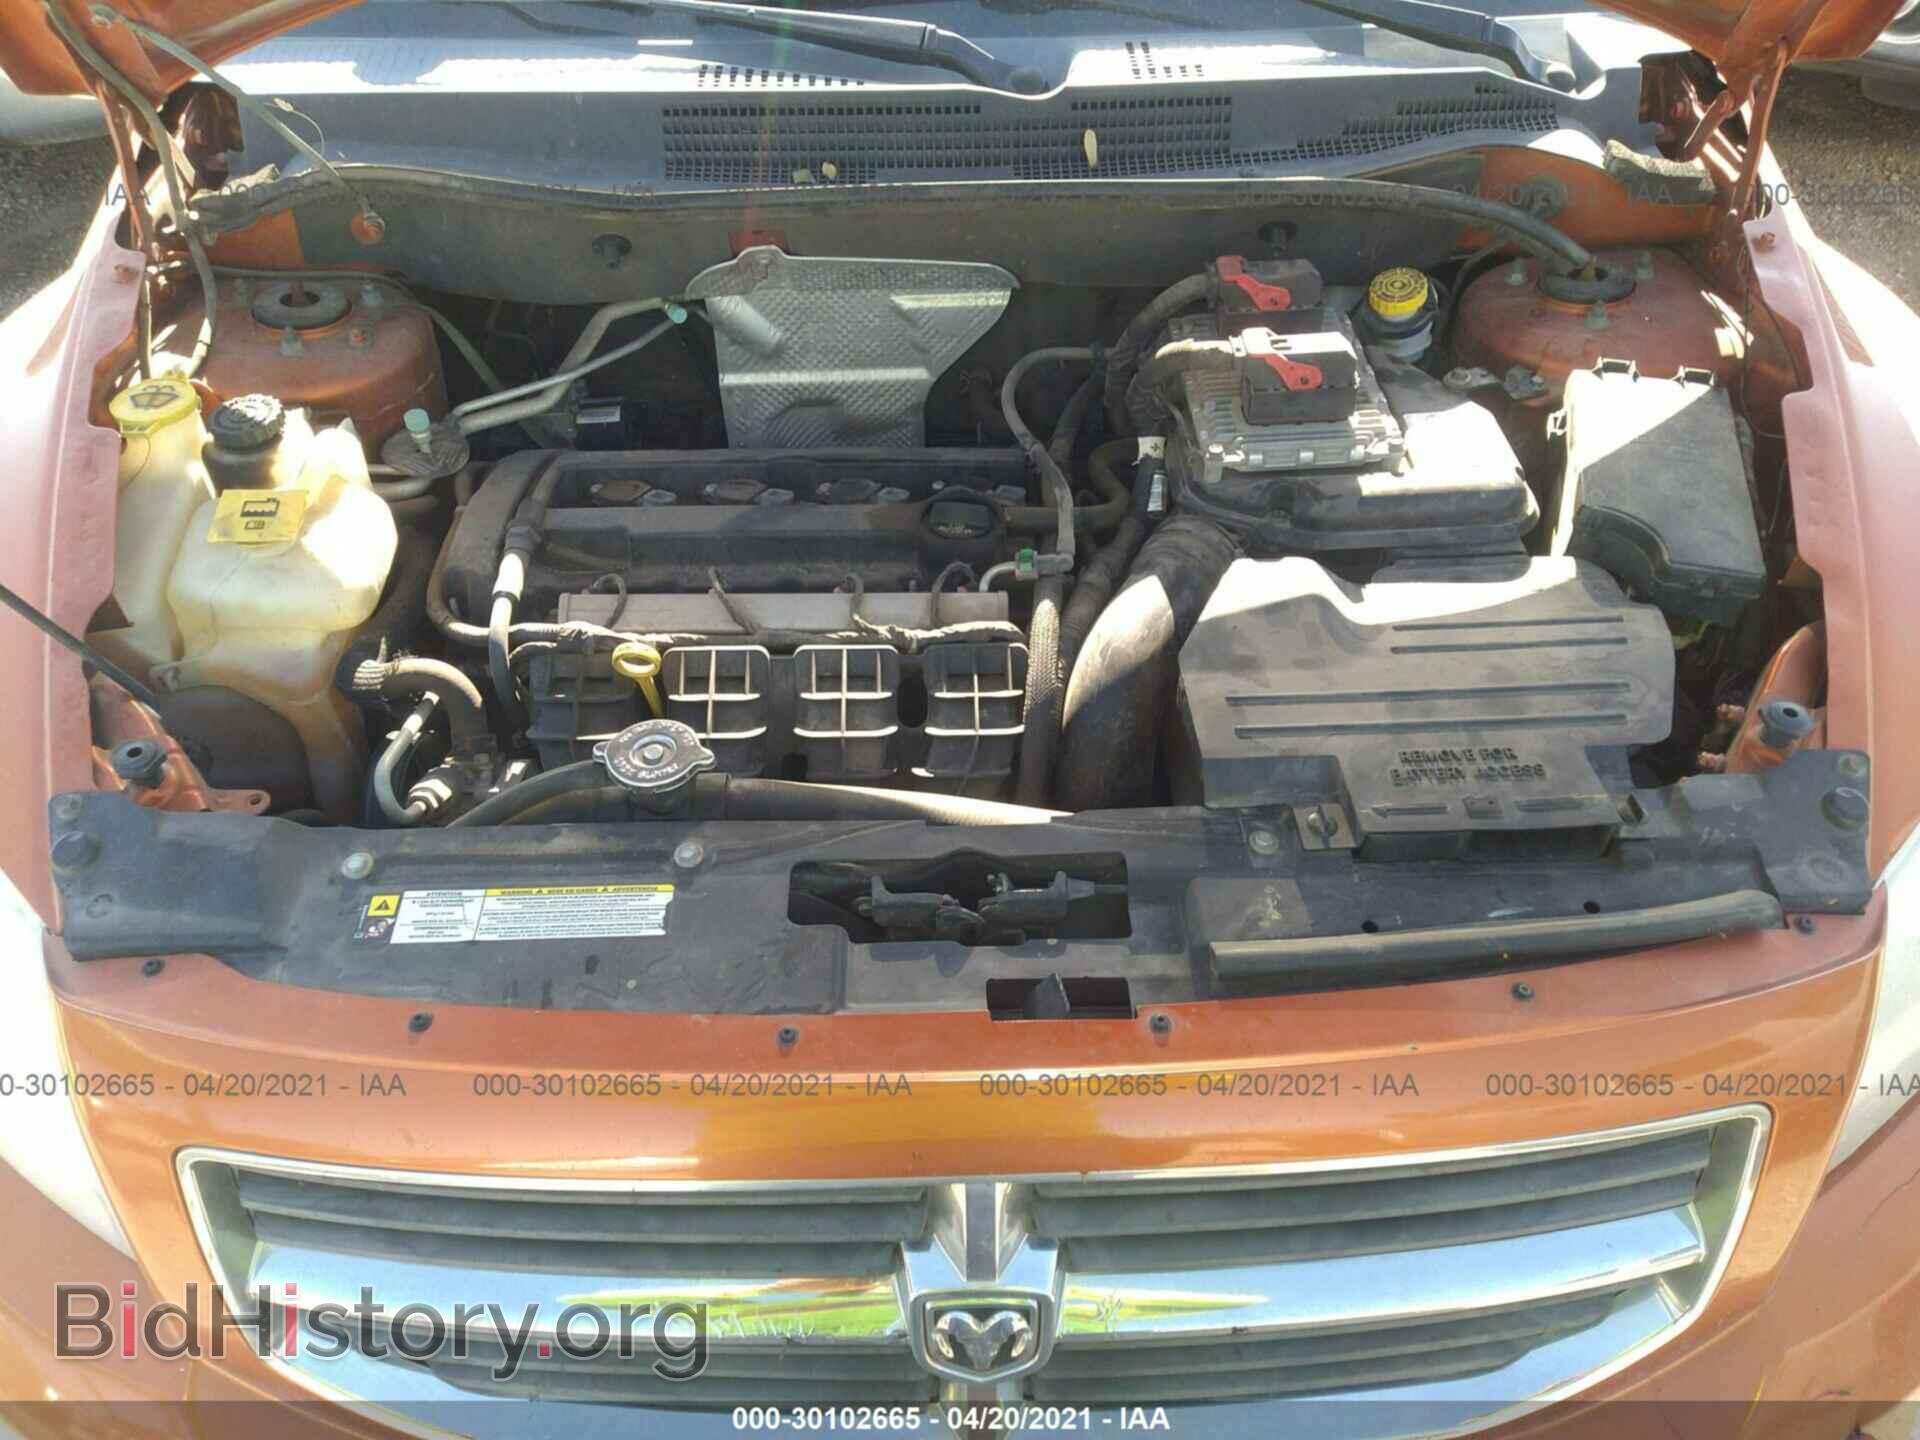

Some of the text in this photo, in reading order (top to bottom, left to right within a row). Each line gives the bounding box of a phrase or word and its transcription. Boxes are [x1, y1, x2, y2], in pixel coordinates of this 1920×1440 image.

[1399, 748, 1518, 765] REMOVE FOR
[1391, 764, 1546, 786] BATTERY ACCESS
